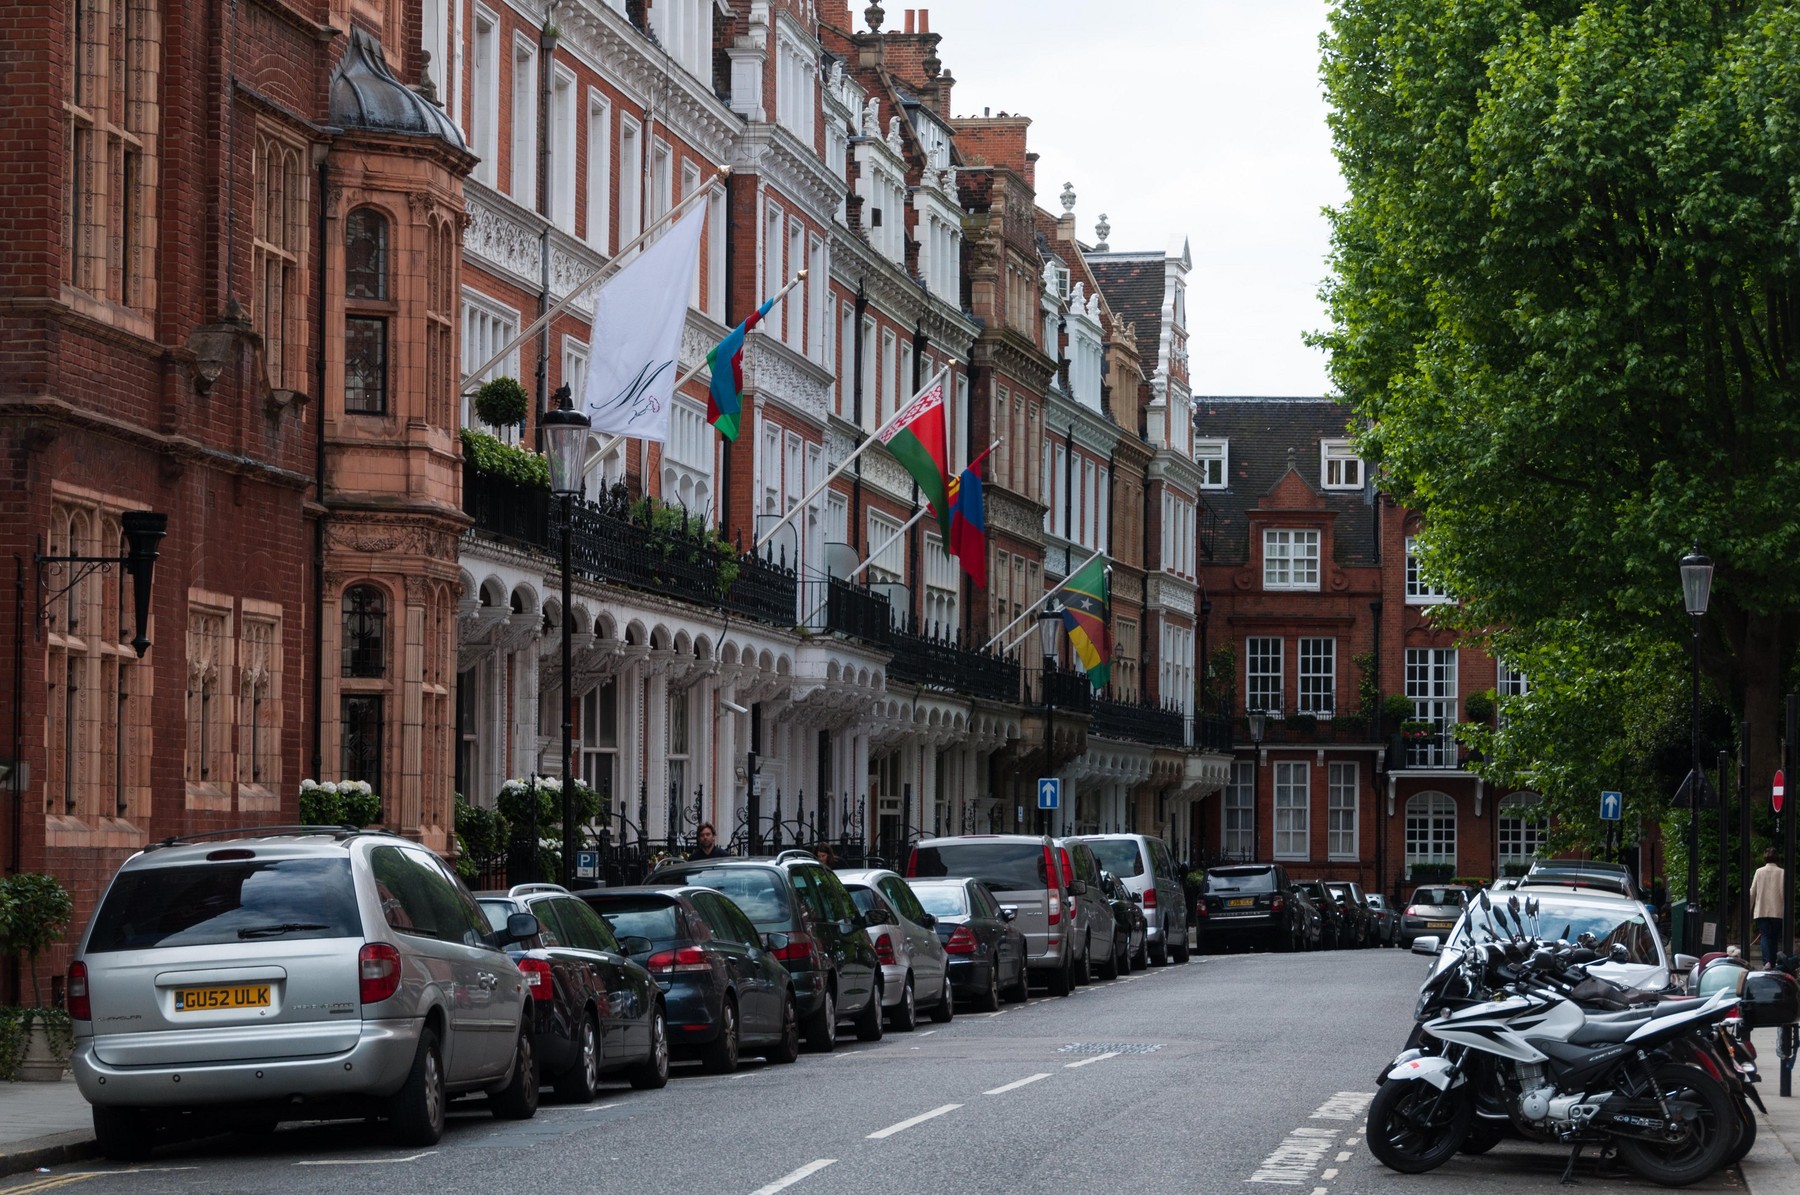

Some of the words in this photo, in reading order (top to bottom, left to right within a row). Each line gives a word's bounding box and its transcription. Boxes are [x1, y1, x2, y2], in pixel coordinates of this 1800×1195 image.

[580, 854, 591, 867] P
[185, 990, 230, 1008] GU52
[235, 988, 268, 1005] ULK
